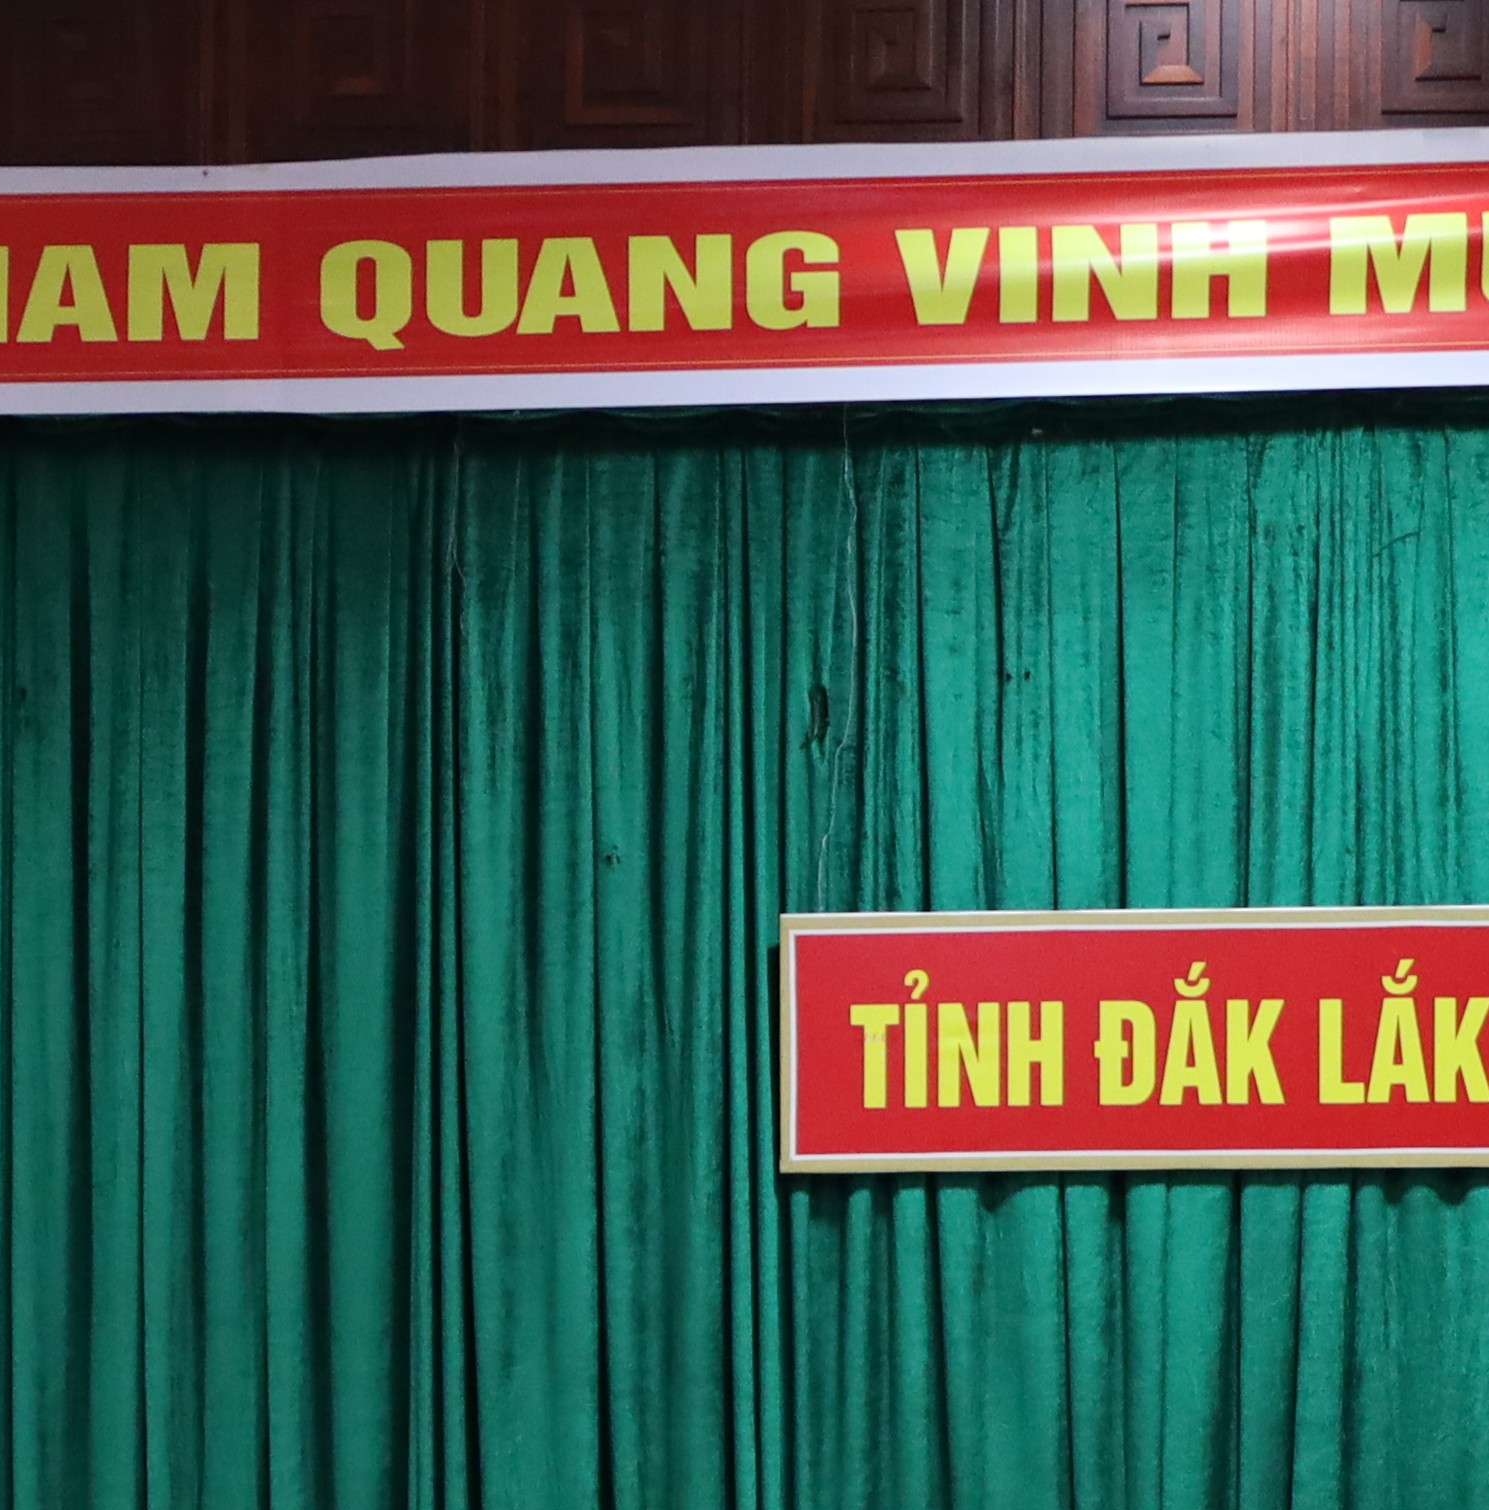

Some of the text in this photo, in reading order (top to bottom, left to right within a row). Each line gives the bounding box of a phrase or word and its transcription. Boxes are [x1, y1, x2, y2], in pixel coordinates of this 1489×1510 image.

[319, 231, 840, 349] QUANG
[894, 222, 1268, 325] VINH
[850, 969, 1064, 1109] TỈNH
[1094, 961, 1285, 1106] ĐẮK
